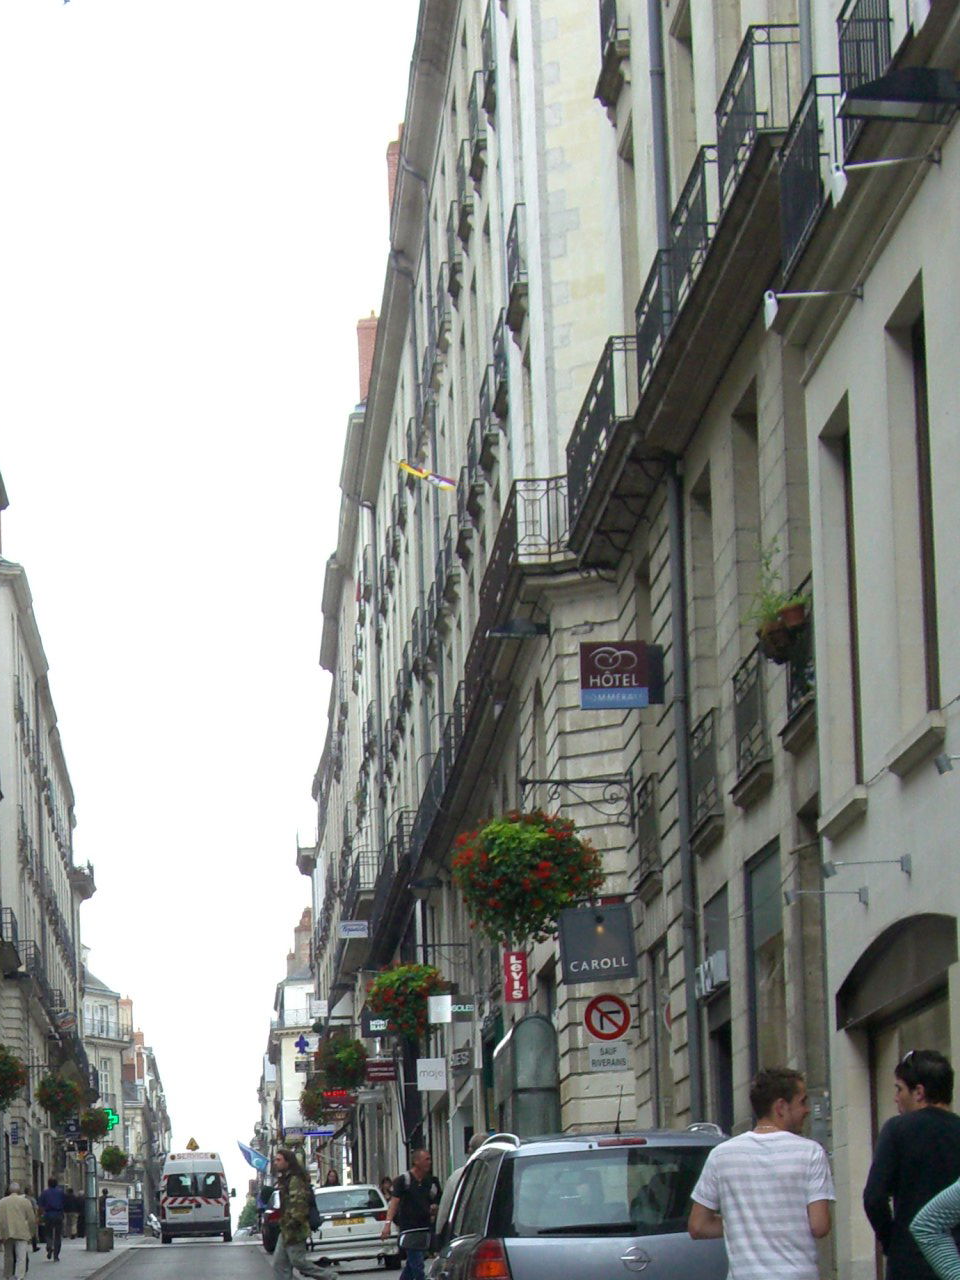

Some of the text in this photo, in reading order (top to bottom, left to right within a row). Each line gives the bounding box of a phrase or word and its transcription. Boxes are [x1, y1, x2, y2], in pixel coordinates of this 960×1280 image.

[590, 670, 639, 687] HÔTEL
[570, 957, 628, 972] CAROLL
[591, 1058, 627, 1068] RIVERAINS
